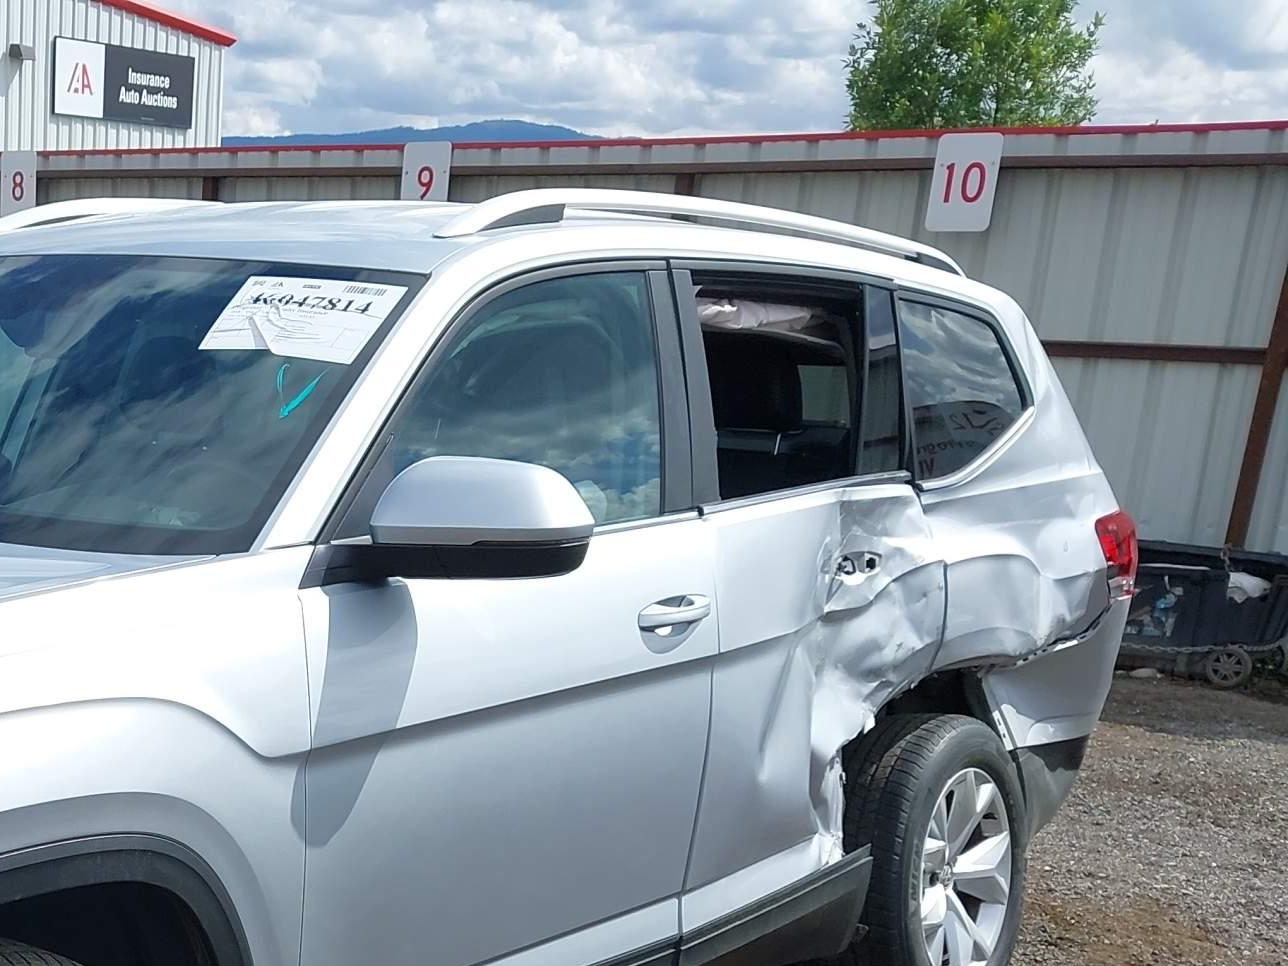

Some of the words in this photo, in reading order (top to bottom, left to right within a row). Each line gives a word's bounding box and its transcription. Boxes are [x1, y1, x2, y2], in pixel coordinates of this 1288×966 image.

[128, 67, 170, 89] Insurance
[119, 86, 140, 105] Auto
[140, 89, 178, 109] Auctions
[12, 171, 24, 202] 8
[417, 166, 434, 200] 9
[943, 161, 987, 203] 10
